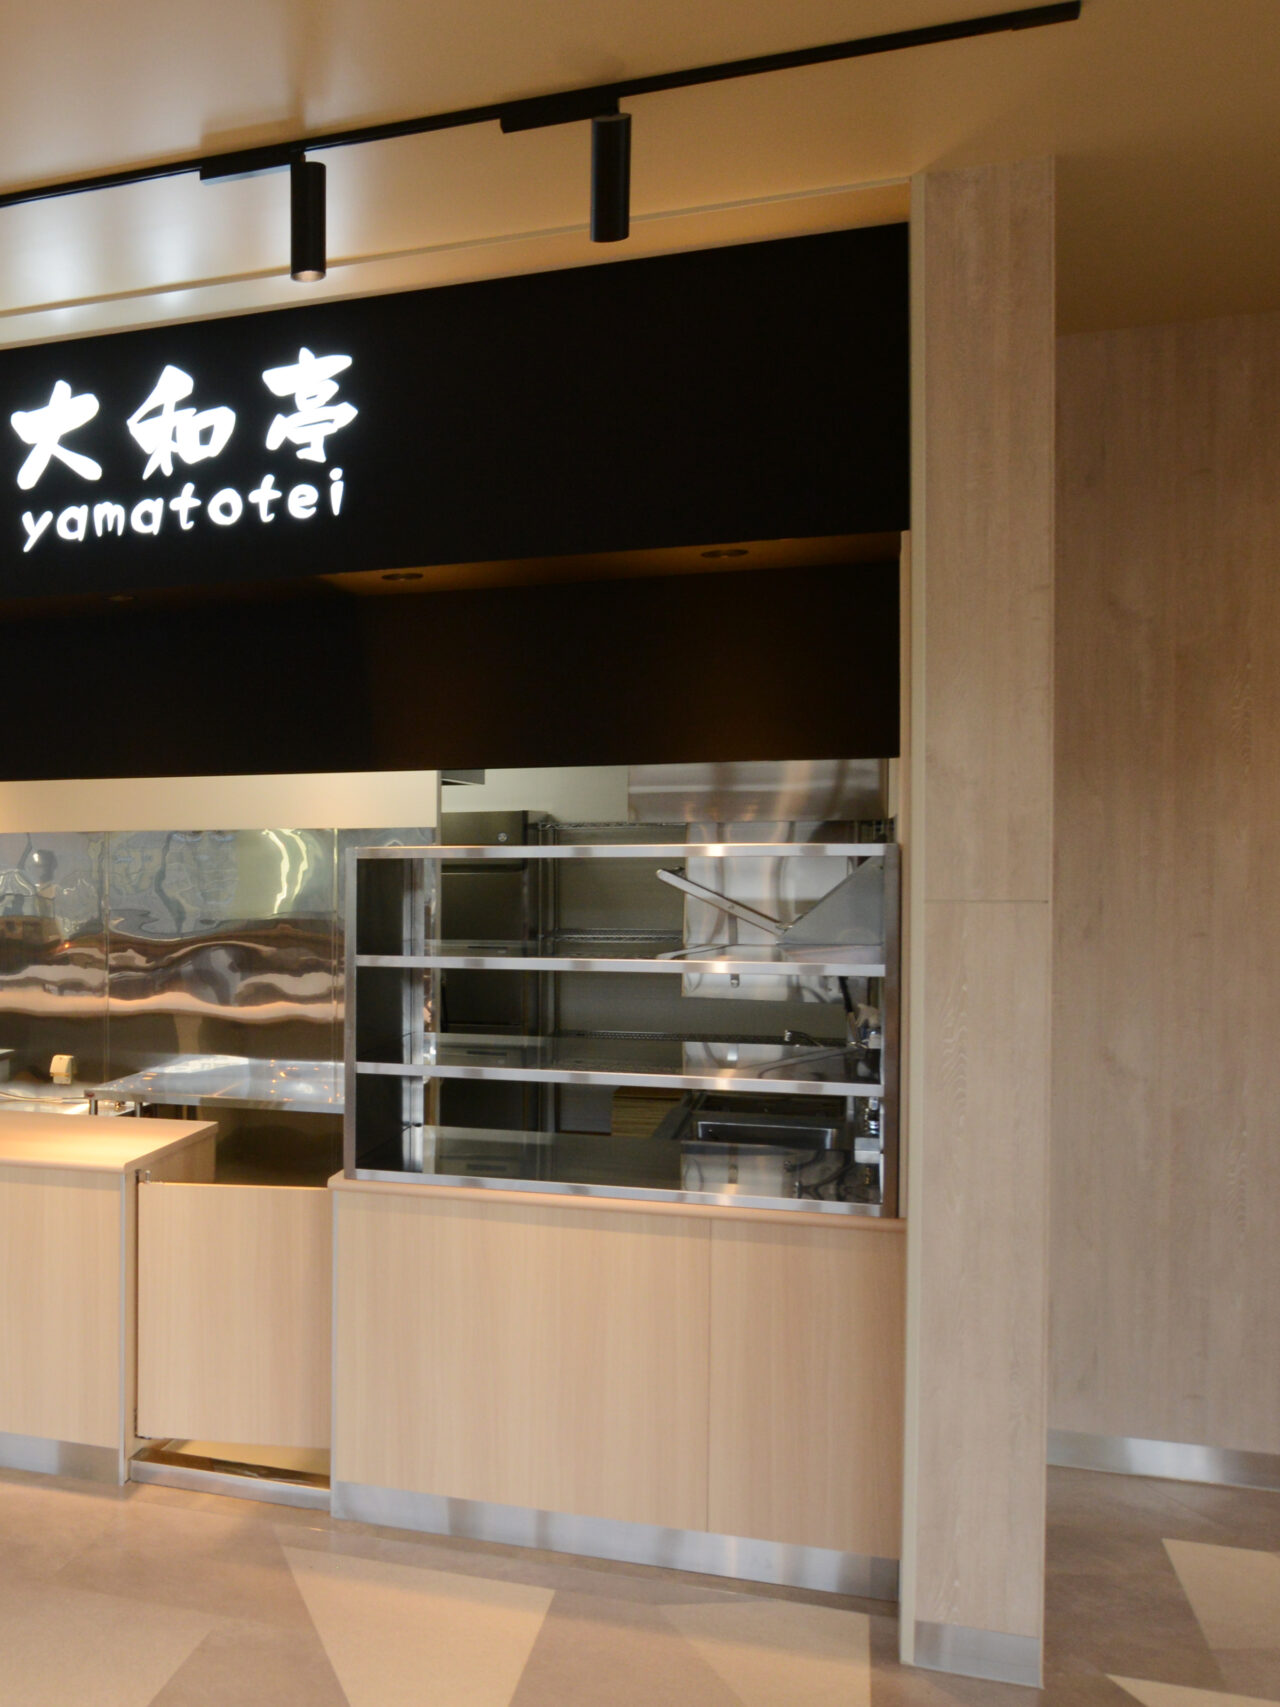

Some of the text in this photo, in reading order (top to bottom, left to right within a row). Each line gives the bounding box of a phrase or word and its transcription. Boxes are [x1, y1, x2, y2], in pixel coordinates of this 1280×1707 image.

[11, 347, 359, 491] 大和亭
[21, 467, 345, 553] yamatotei
